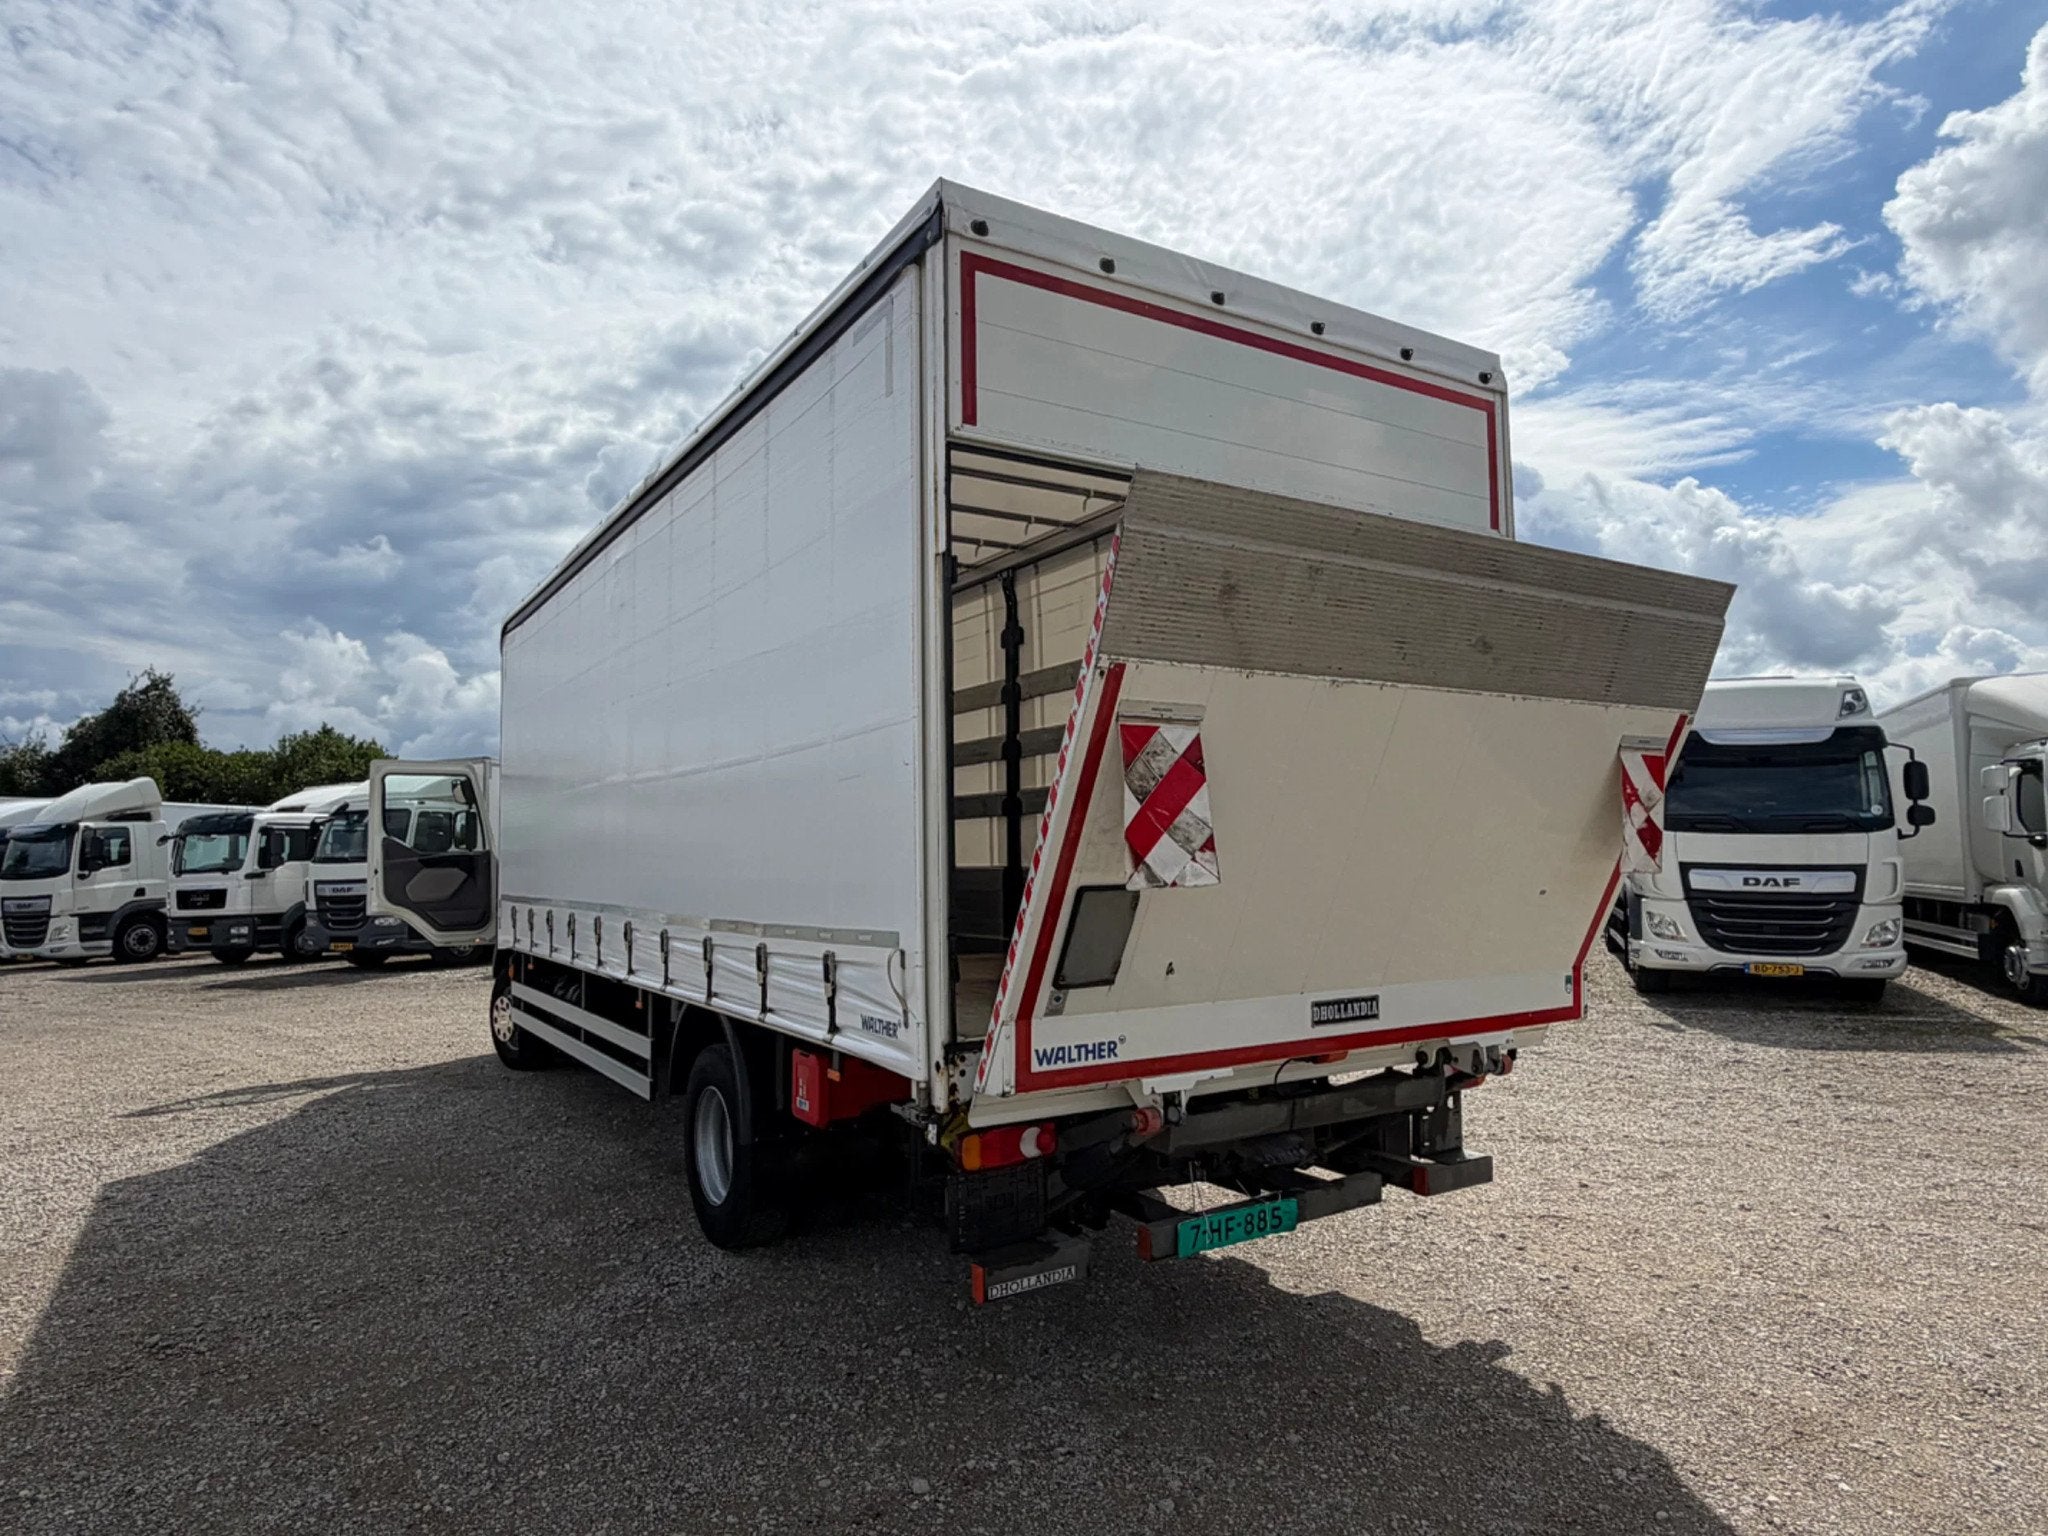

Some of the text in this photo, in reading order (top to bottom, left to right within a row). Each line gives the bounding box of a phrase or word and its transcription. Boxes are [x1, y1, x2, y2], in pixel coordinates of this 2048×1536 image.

[1743, 877, 1801, 887] DAF
[1313, 1001, 1378, 1021] DHOLLANDIA
[861, 1014, 899, 1039] WALTHER
[1034, 1040, 1118, 1067] WALTHER
[1190, 1206, 1283, 1249] 7-HF-885
[989, 1266, 1075, 1299] DHOLLANDIA
